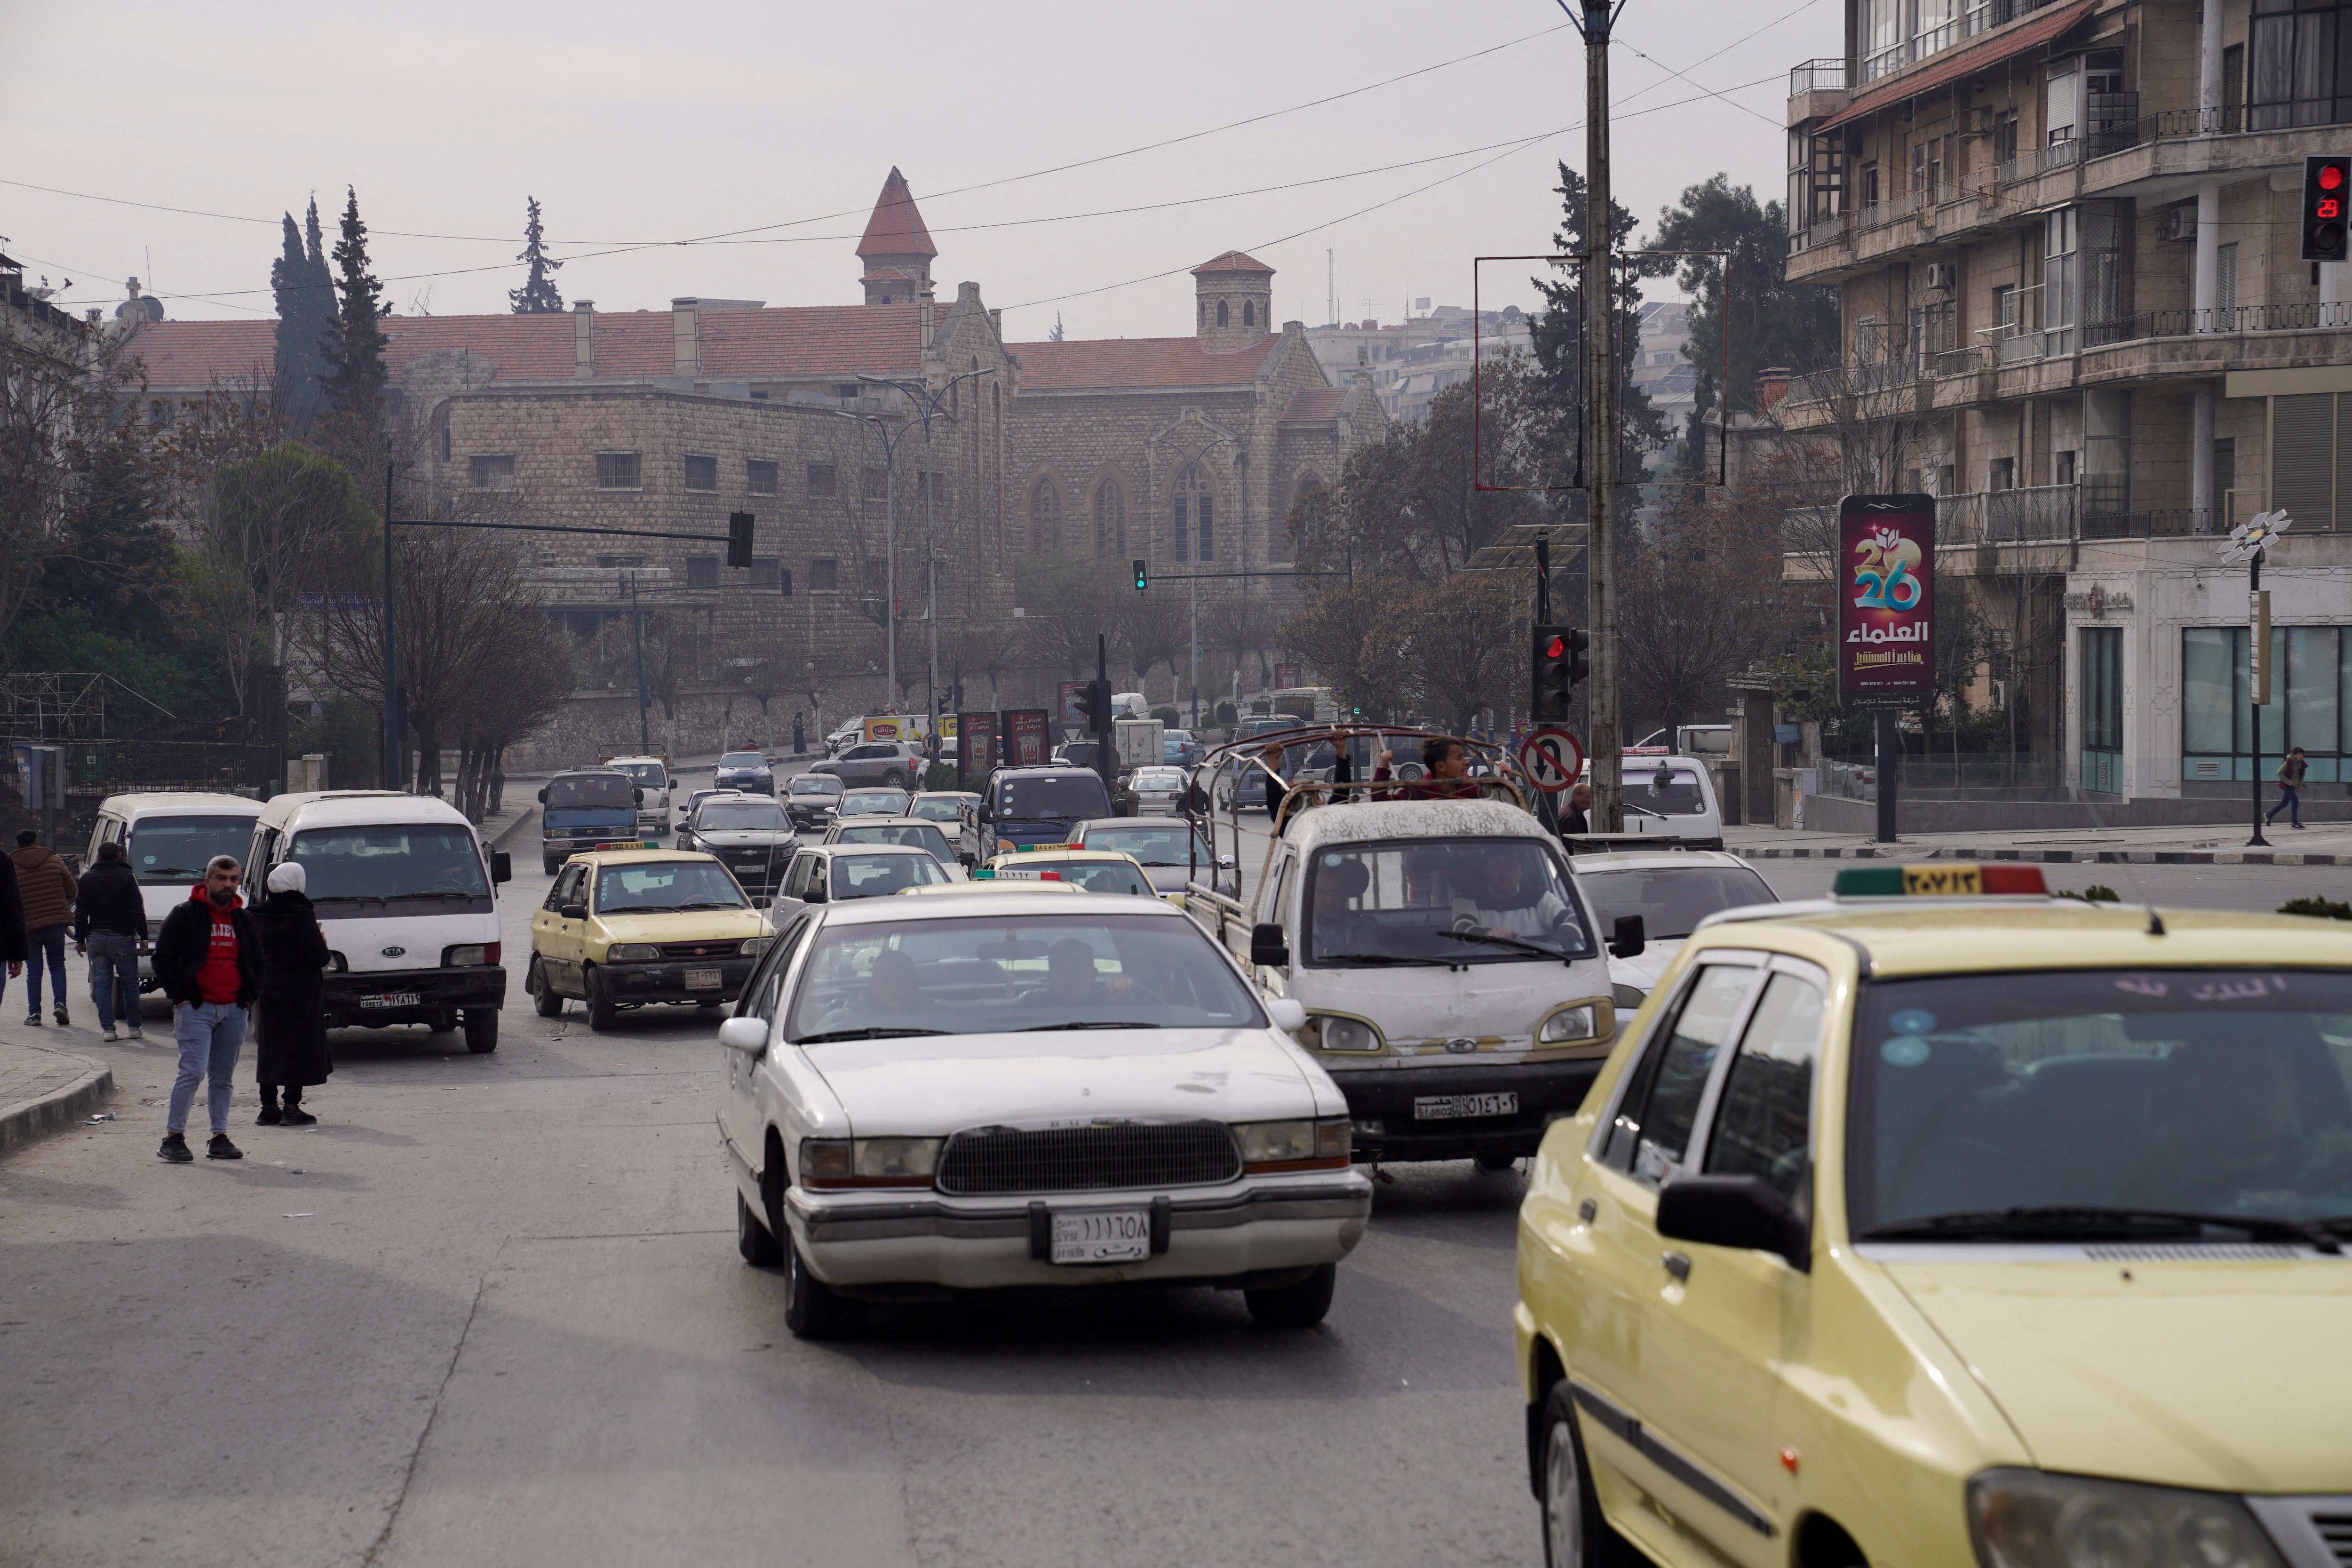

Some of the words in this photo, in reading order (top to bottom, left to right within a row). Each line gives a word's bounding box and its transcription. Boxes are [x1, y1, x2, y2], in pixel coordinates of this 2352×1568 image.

[1854, 559, 1922, 611] 26
[1845, 621, 1928, 644] العلماء
[1854, 651, 1891, 665] المستقبل
[1892, 648, 1907, 665] يبدأ
[1907, 651, 1921, 662] هنا
[1468, 1094, 1515, 1114] ٥١٤٦٠٢
[1085, 1215, 1146, 1240] ١١١٦٥٨
[1056, 1232, 1078, 1242] SYR
[1093, 1245, 1142, 1258] دمشق
